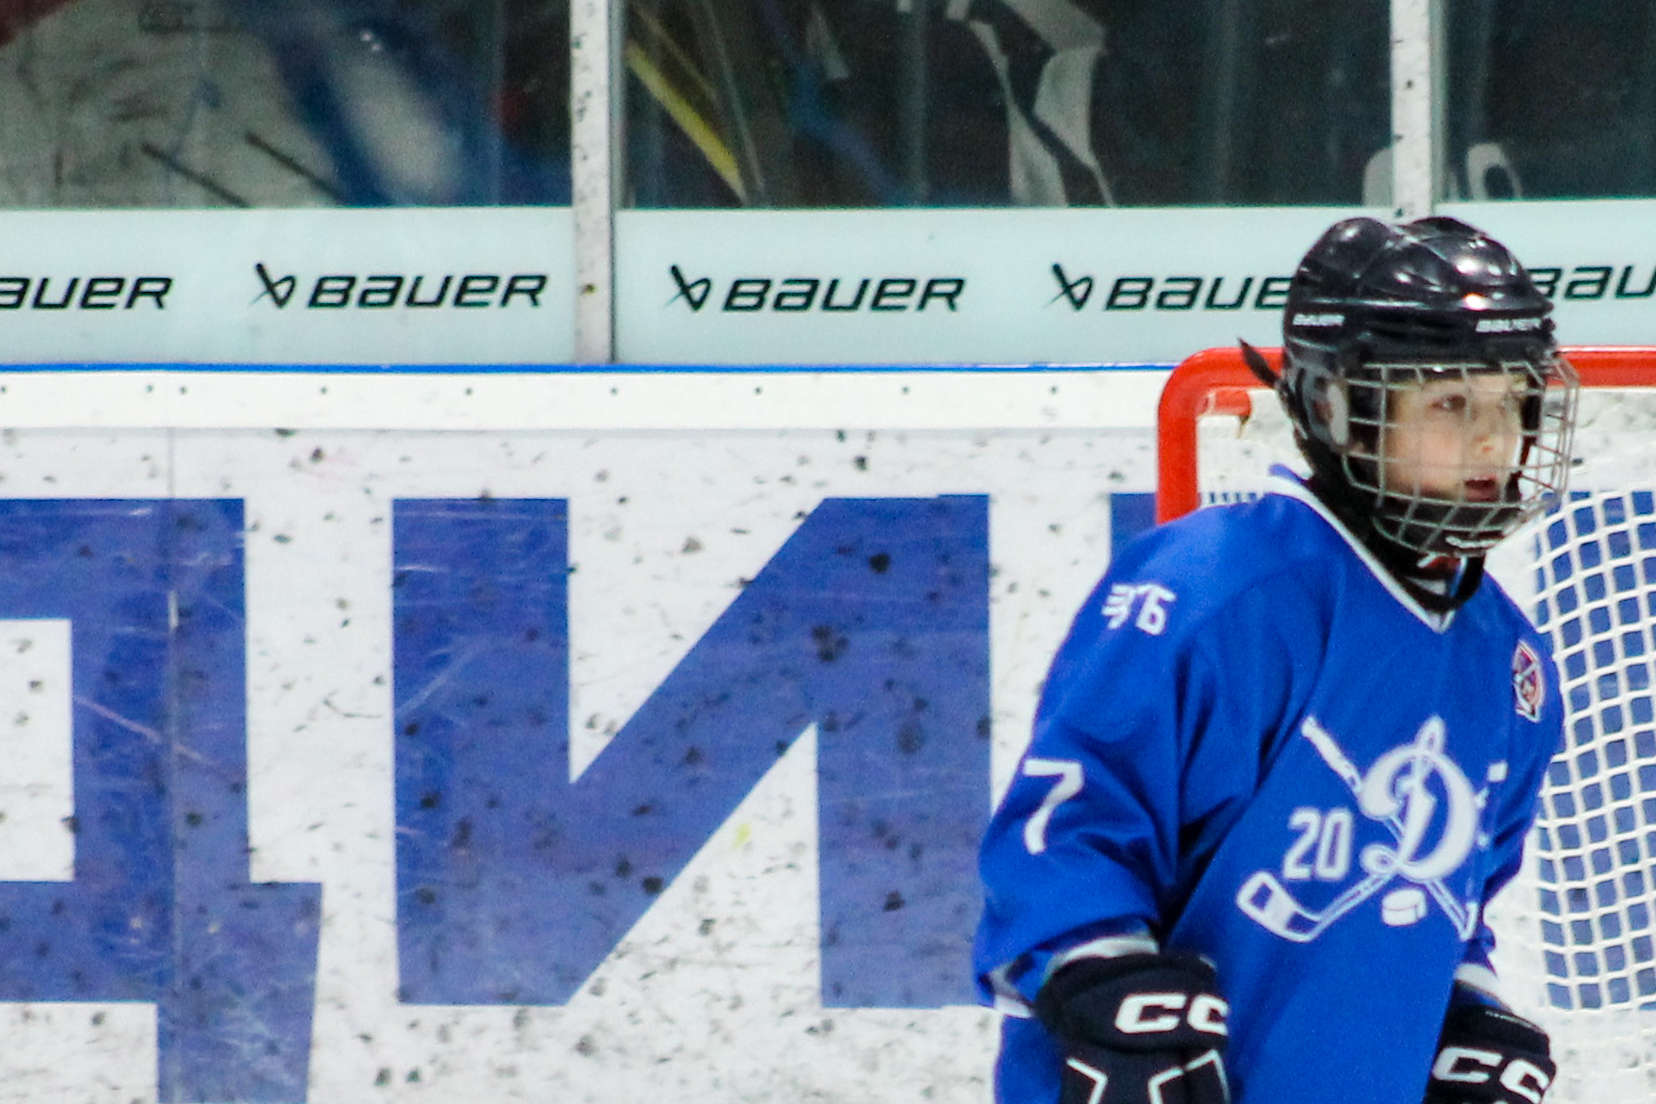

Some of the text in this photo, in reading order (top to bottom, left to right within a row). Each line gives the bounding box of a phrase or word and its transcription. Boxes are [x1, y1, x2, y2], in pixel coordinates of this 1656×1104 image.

[0, 276, 173, 309] AUER
[307, 274, 548, 308] BAUER
[722, 278, 966, 312] BAUER
[1104, 276, 1292, 311] BAUE
[1022, 757, 1085, 855] 7
[1114, 992, 1228, 1035] CC
[1432, 1046, 1550, 1104] CC
